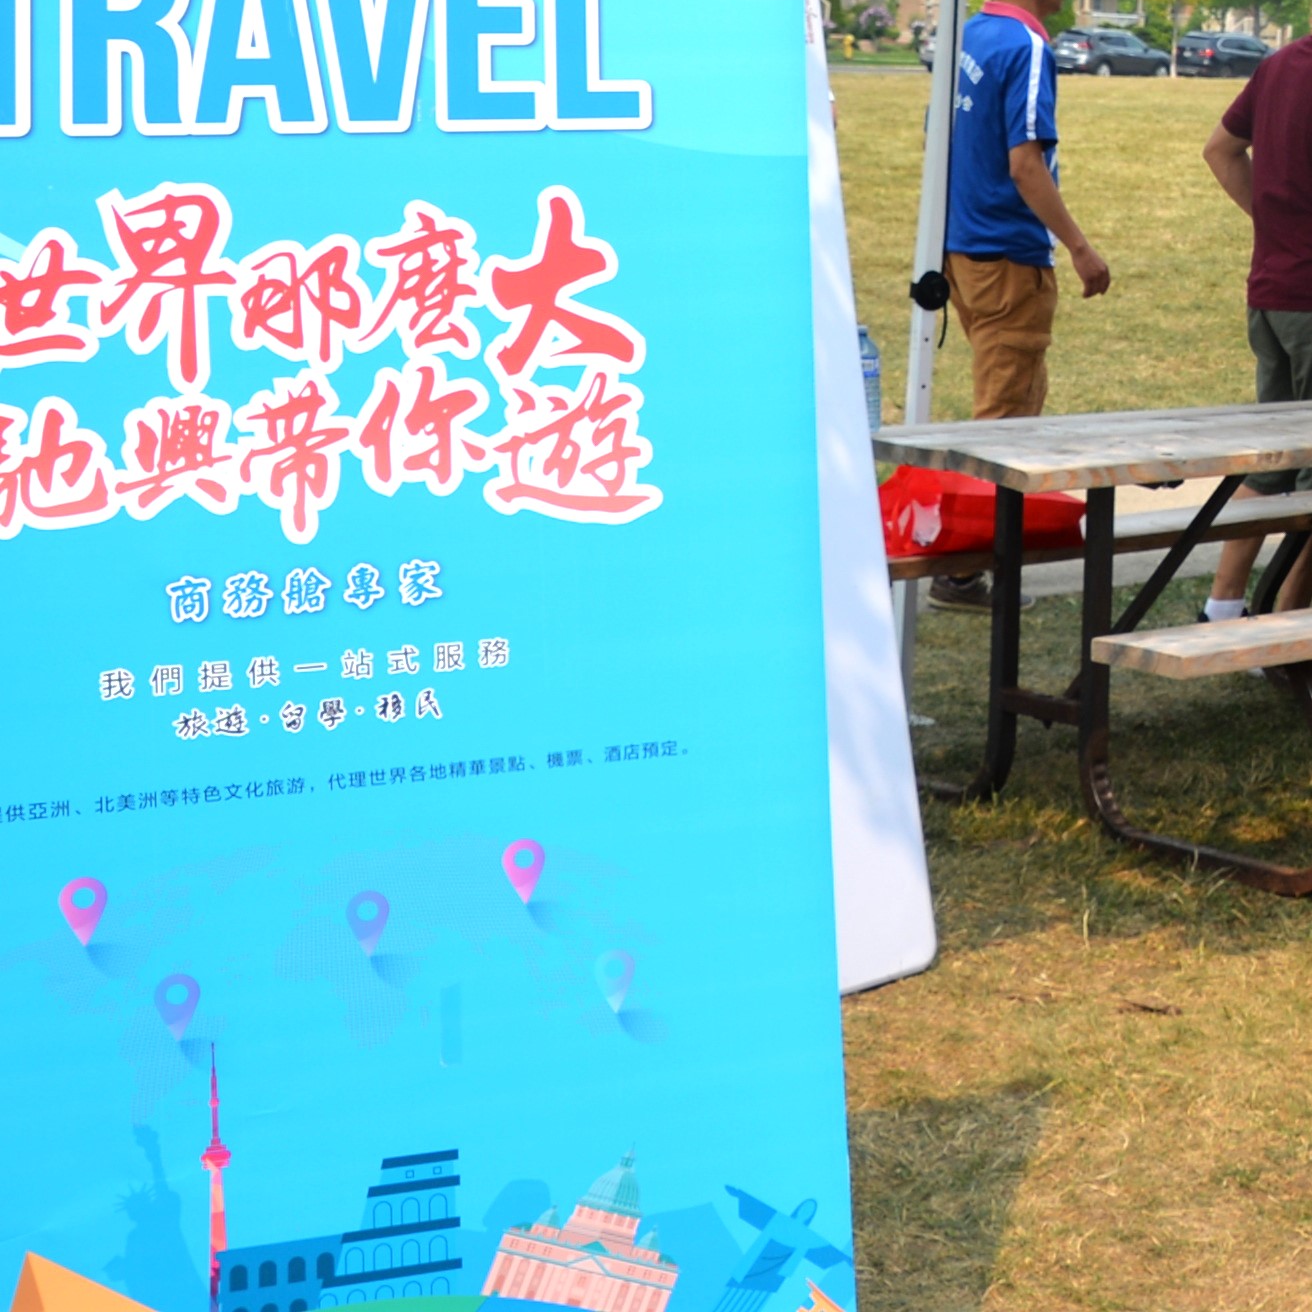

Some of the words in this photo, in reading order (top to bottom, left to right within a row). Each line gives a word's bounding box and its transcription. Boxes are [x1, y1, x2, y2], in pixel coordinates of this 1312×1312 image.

[166, 558, 443, 625] 商務艙專家
[101, 637, 510, 700] 我們提供一站式服務
